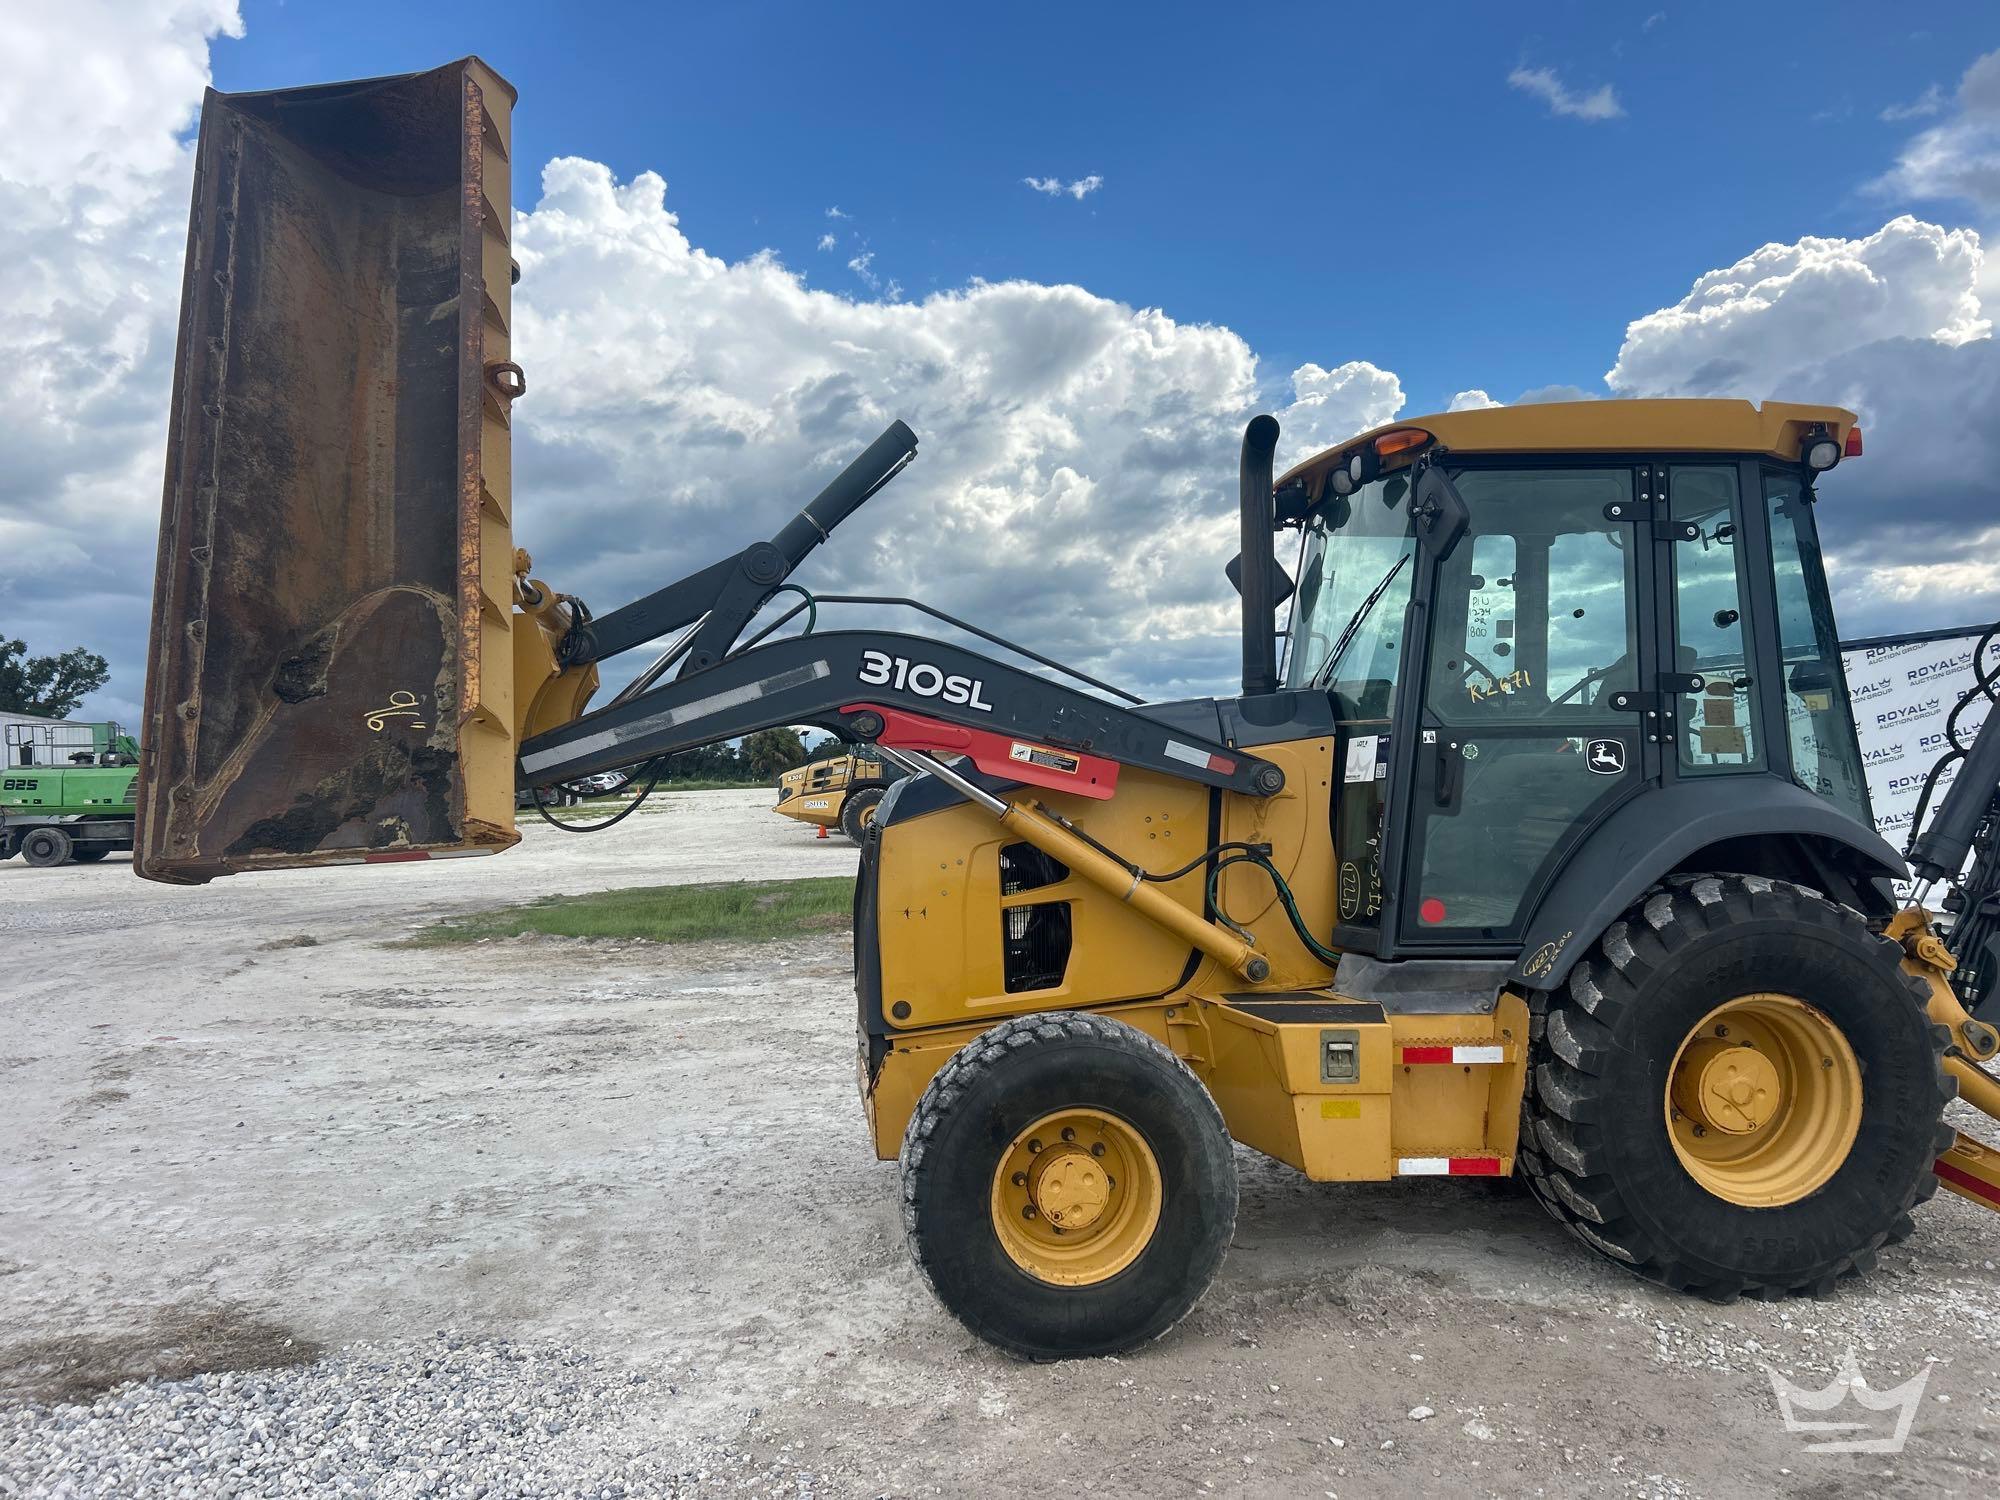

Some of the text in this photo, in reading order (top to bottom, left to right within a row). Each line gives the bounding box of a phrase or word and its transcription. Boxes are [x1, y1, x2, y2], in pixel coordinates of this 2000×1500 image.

[1467, 626, 1487, 638] 1800
[1868, 642, 1929, 666] AUCTION GROUP
[1908, 658, 1958, 680] ROYAL
[1910, 662, 1975, 687] AUCTION GROUP
[859, 650, 992, 712] 310SL
[1852, 683, 1879, 696] YAL
[1866, 688, 1893, 700] GROUP
[1877, 703, 1927, 724] ROYAL
[1879, 708, 1941, 730] AUCTION GROUP
[1922, 742, 1951, 753] AUCTIO
[1863, 748, 1890, 761] YAL
[1878, 753, 1905, 765] GROUP
[3, 779, 38, 791] 825
[1889, 772, 1929, 789] ROYA
[1874, 814, 1903, 826] YAL
[1890, 821, 1914, 831] GROU
[1341, 864, 1357, 909] 4221
